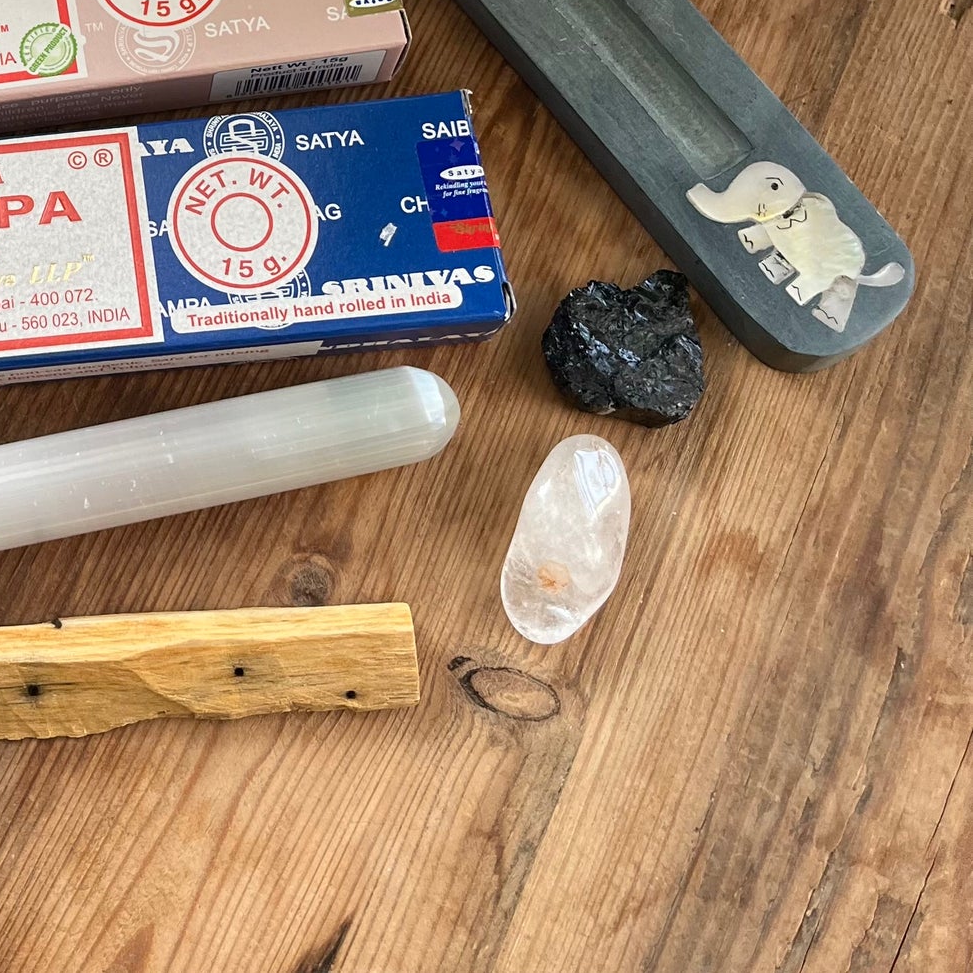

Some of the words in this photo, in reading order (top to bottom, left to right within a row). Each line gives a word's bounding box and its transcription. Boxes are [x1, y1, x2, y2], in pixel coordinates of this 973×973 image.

[204, 16, 270, 38] SATYA
[250, 64, 282, 74] Nett
[296, 129, 365, 151] SATYA
[30, 291, 59, 306] 400
[187, 306, 288, 329] Traditionally
[293, 301, 334, 317] hand
[339, 296, 386, 314] rolled
[391, 294, 406, 309] in
[411, 290, 452, 306] India
[21, 316, 48, 330] 560
[52, 313, 83, 329] 023,
[87, 306, 131, 324] INDIA
